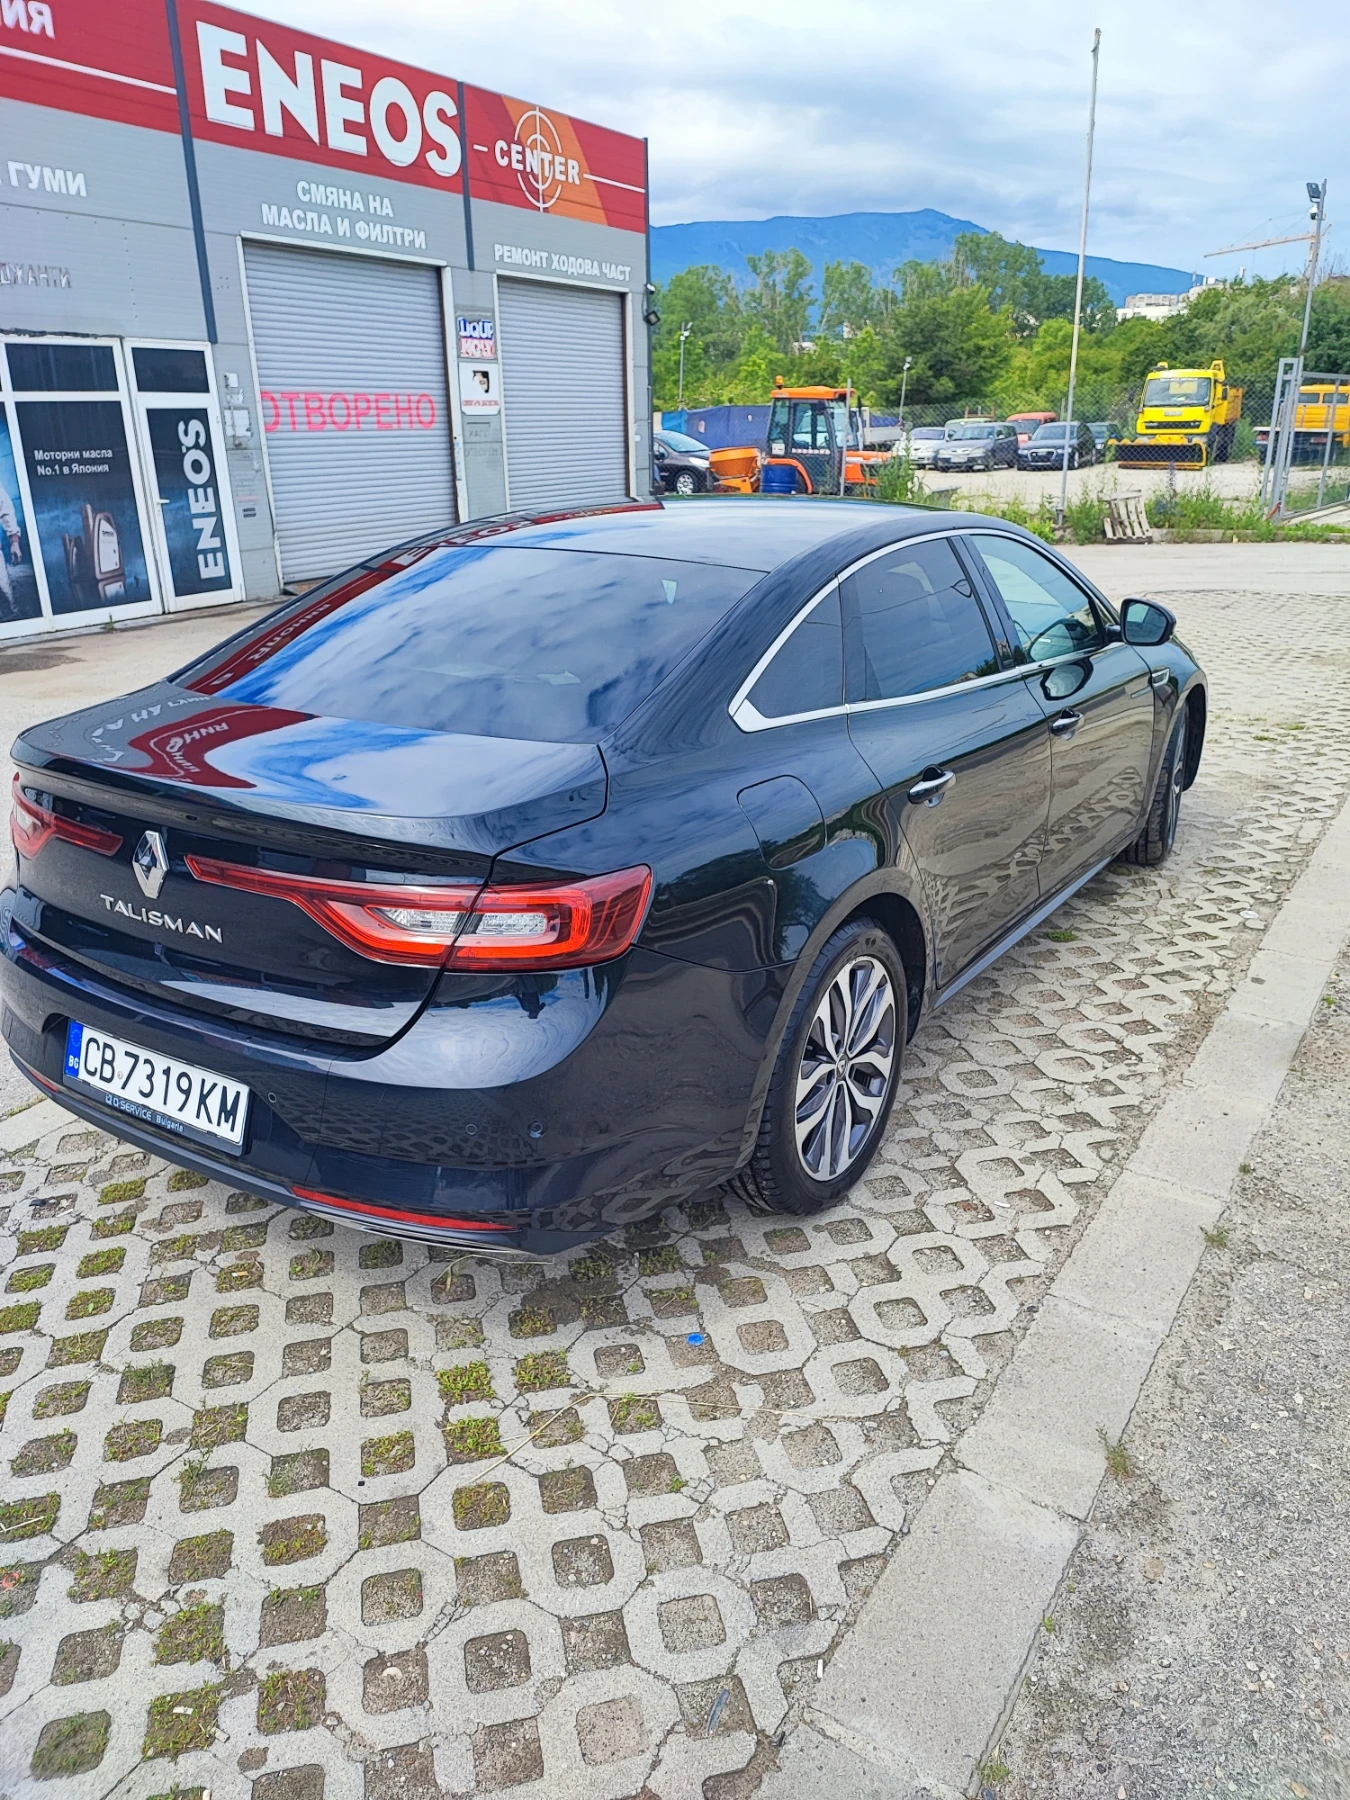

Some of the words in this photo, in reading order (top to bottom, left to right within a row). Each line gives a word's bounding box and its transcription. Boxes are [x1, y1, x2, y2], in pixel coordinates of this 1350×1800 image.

[0, 0, 55, 40] ИЯ
[196, 20, 463, 177] ENEOS
[7, 160, 88, 198] ГУМИ
[494, 139, 581, 186] CENTER
[296, 180, 365, 212] СМЯНА
[368, 194, 395, 218] НА
[261, 203, 333, 235] МАСЛА
[336, 216, 351, 238] И
[355, 220, 427, 249] ФИЛТРИ
[494, 244, 549, 268] РЕМОНТ
[551, 253, 601, 276] ХОДОВА
[601, 262, 632, 281] ЧАСТ
[261, 390, 437, 433] ОТВОРЕНО
[34, 449, 80, 461] Моторни
[82, 449, 113, 459] масла
[37, 464, 60, 476] No.1
[62, 465, 70, 474] в
[71, 463, 109, 474] Япония
[100, 893, 224, 944] TALISMAN
[68, 1054, 80, 1070] BG
[119, 1100, 152, 1120] SERVICE
